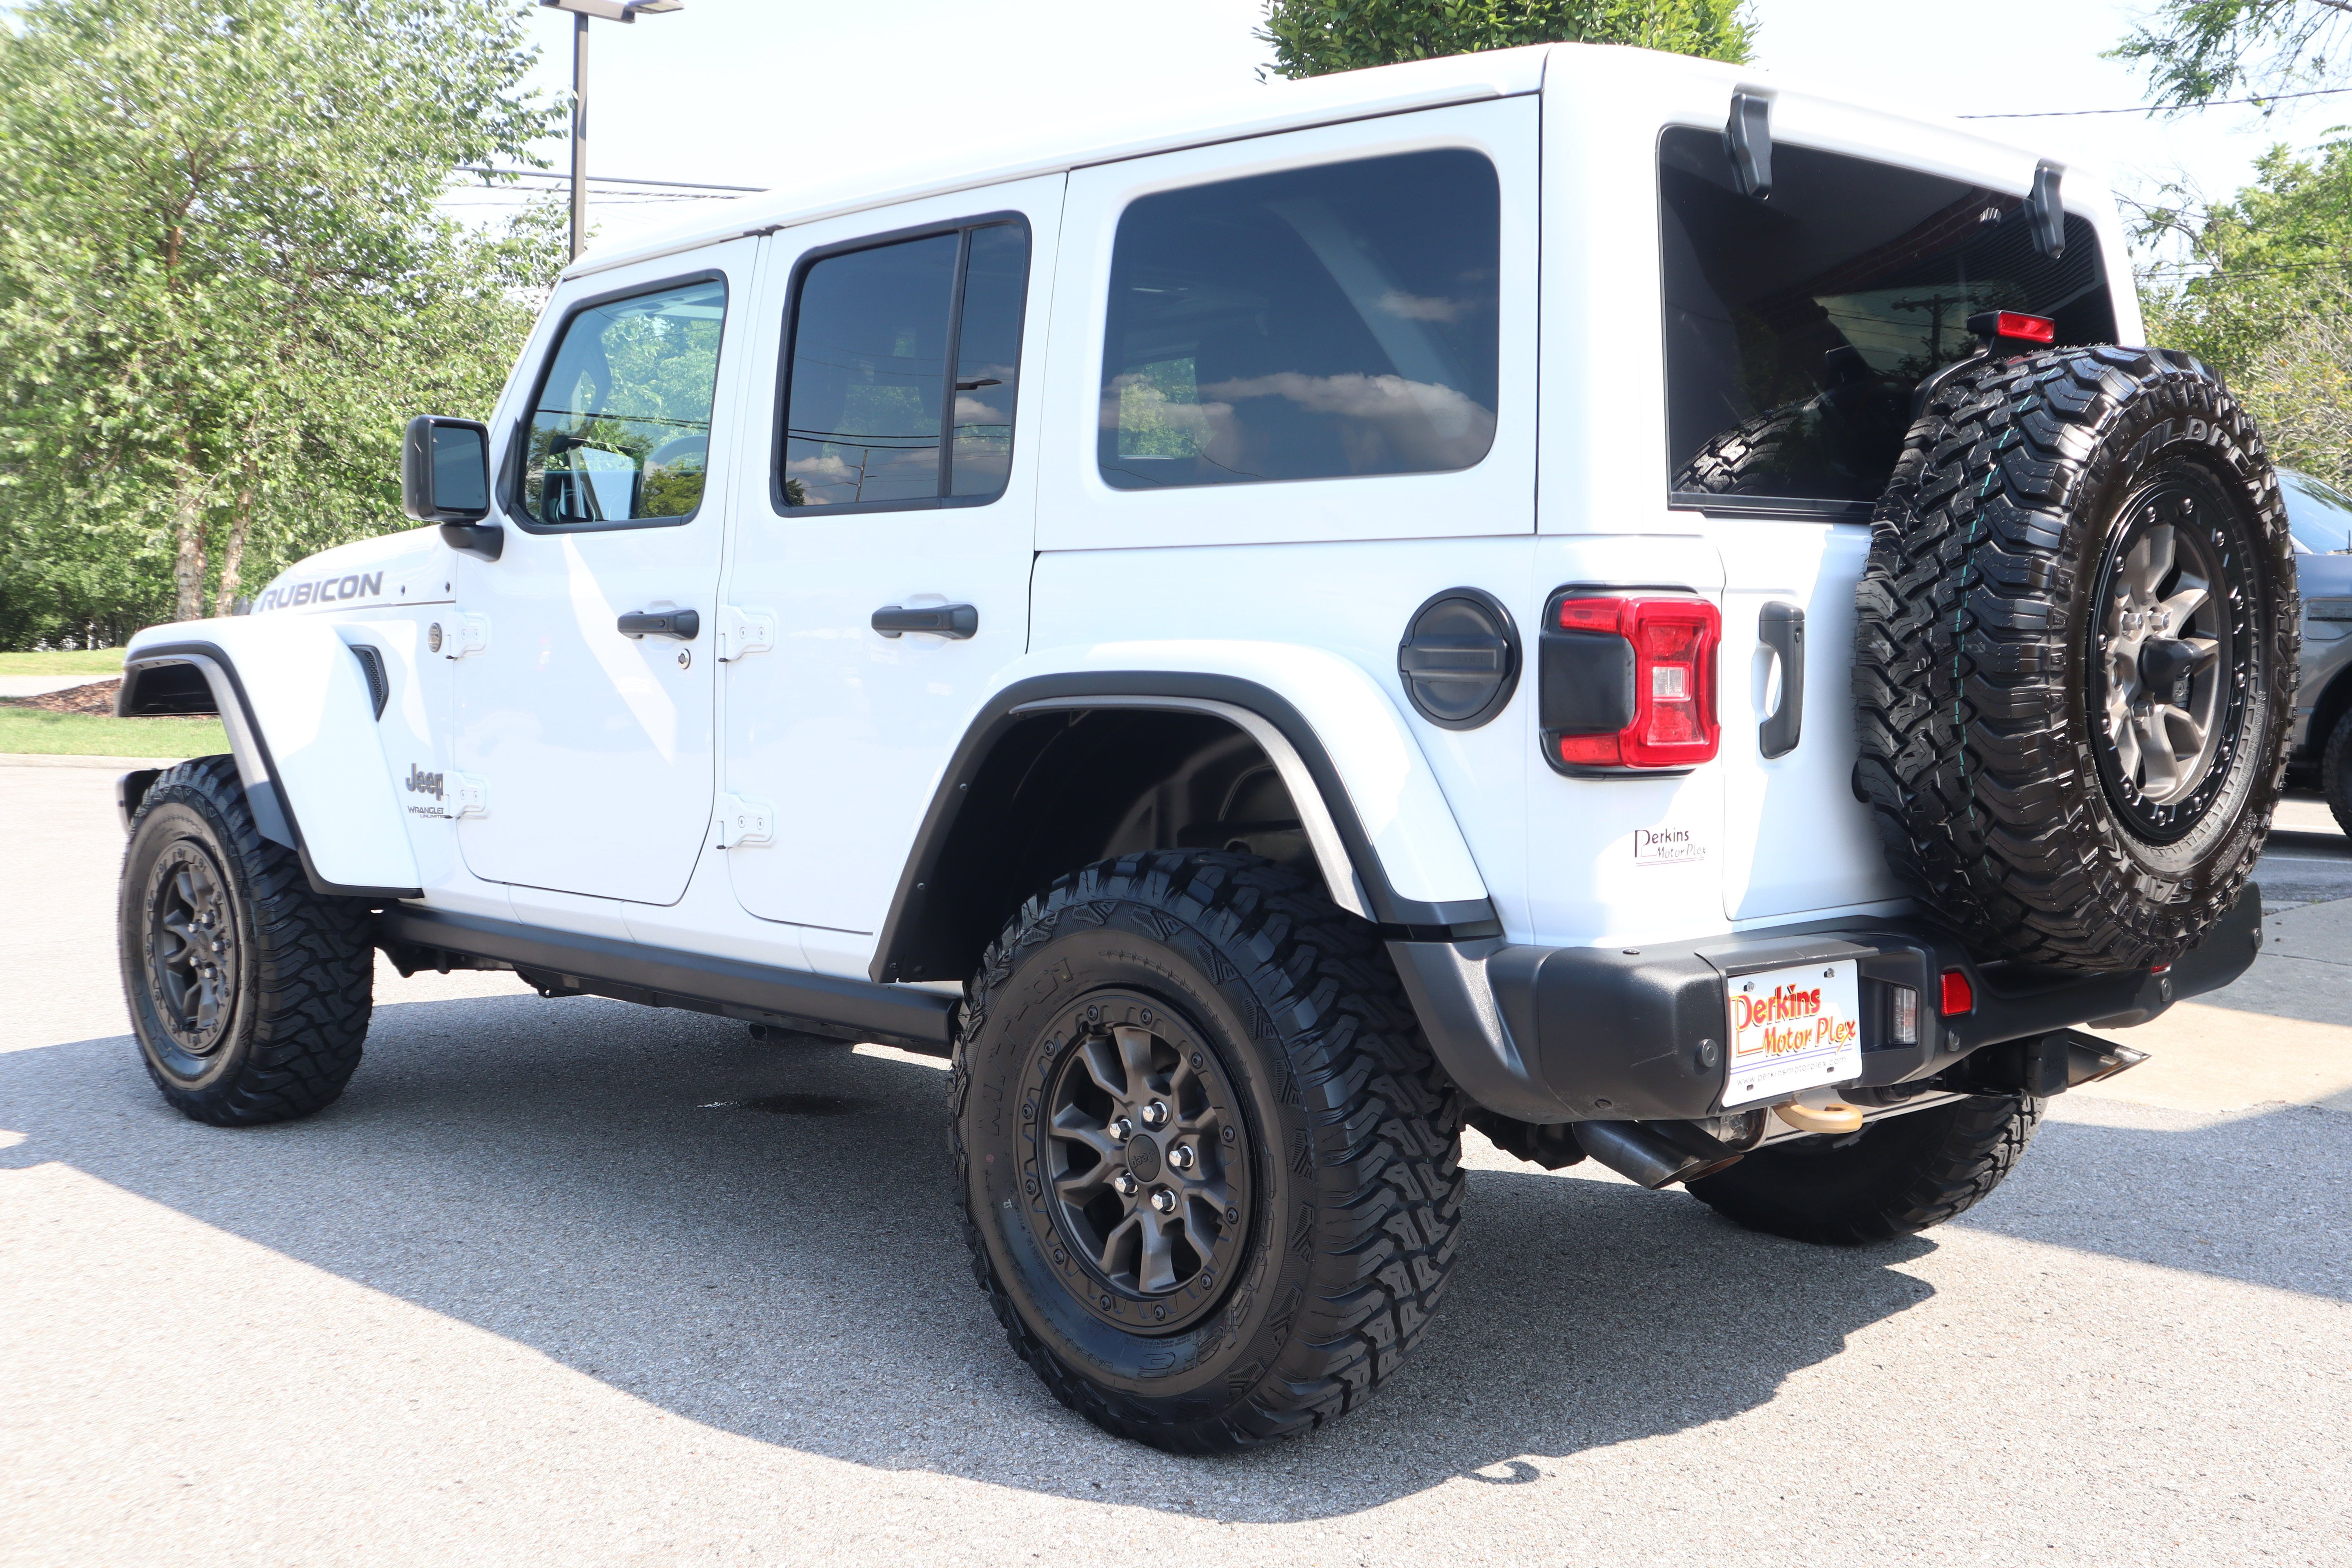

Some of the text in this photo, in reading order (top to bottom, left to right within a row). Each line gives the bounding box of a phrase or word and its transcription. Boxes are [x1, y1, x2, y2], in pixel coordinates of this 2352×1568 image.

[258, 570, 384, 612] RUBICON
[405, 763, 443, 801] Jeep
[1635, 827, 1689, 858] Perkins
[1656, 846, 1685, 858] Motor
[1728, 983, 1822, 1035] Perkins
[1762, 1015, 1857, 1057] Motor Plex
[1737, 1056, 1846, 1086] wwwperkinsmotorplexcom
